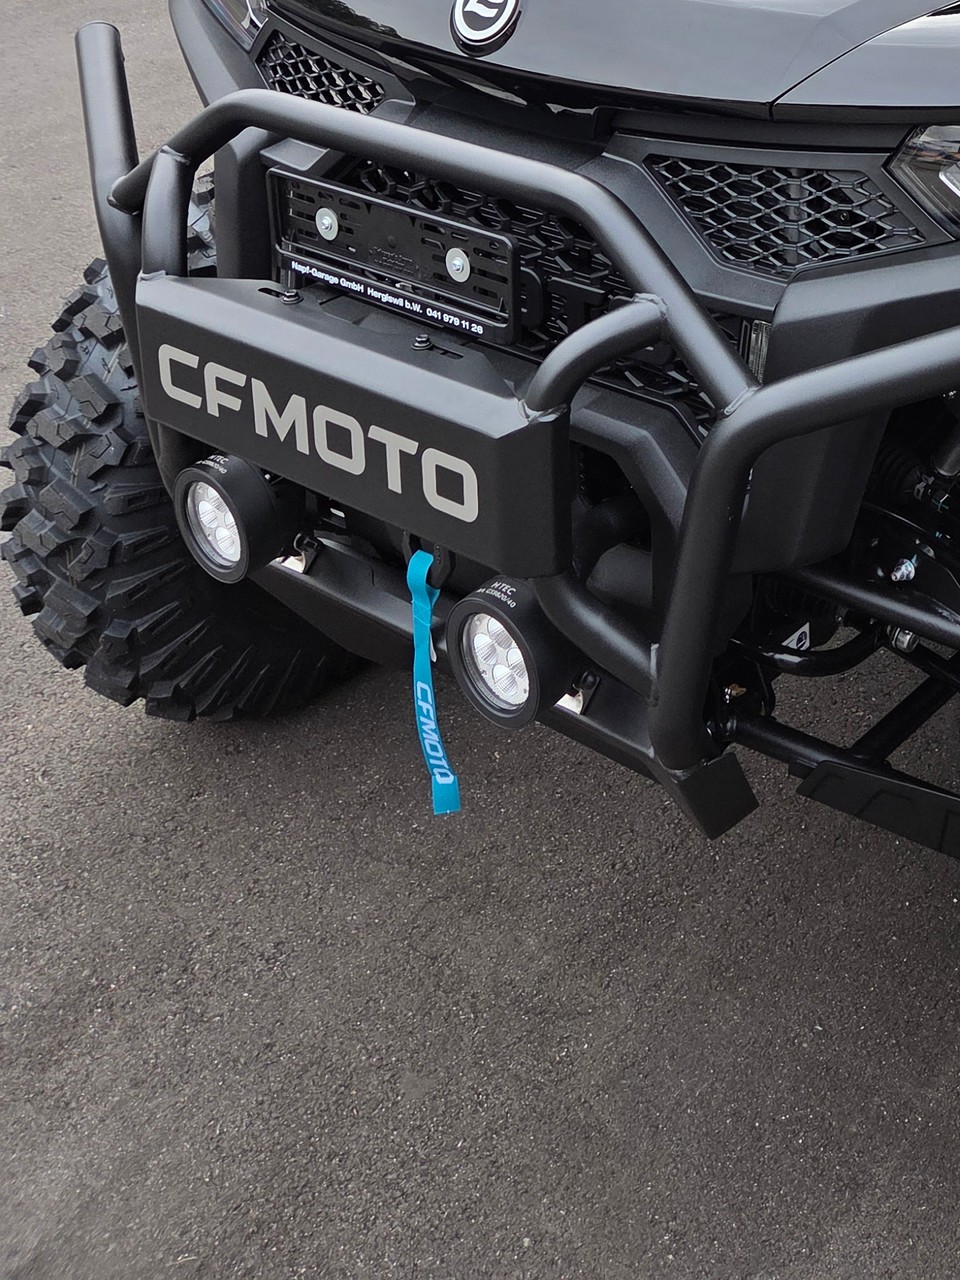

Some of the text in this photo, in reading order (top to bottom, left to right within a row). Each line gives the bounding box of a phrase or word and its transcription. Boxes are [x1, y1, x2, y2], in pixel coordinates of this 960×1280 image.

[291, 261, 339, 285] Napf-Garage
[339, 277, 364, 293] GmbH
[426, 307, 442, 320] 041
[460, 319, 470, 330] 11
[157, 342, 480, 524] CFMOTO
[416, 680, 455, 785] CFMOTO
